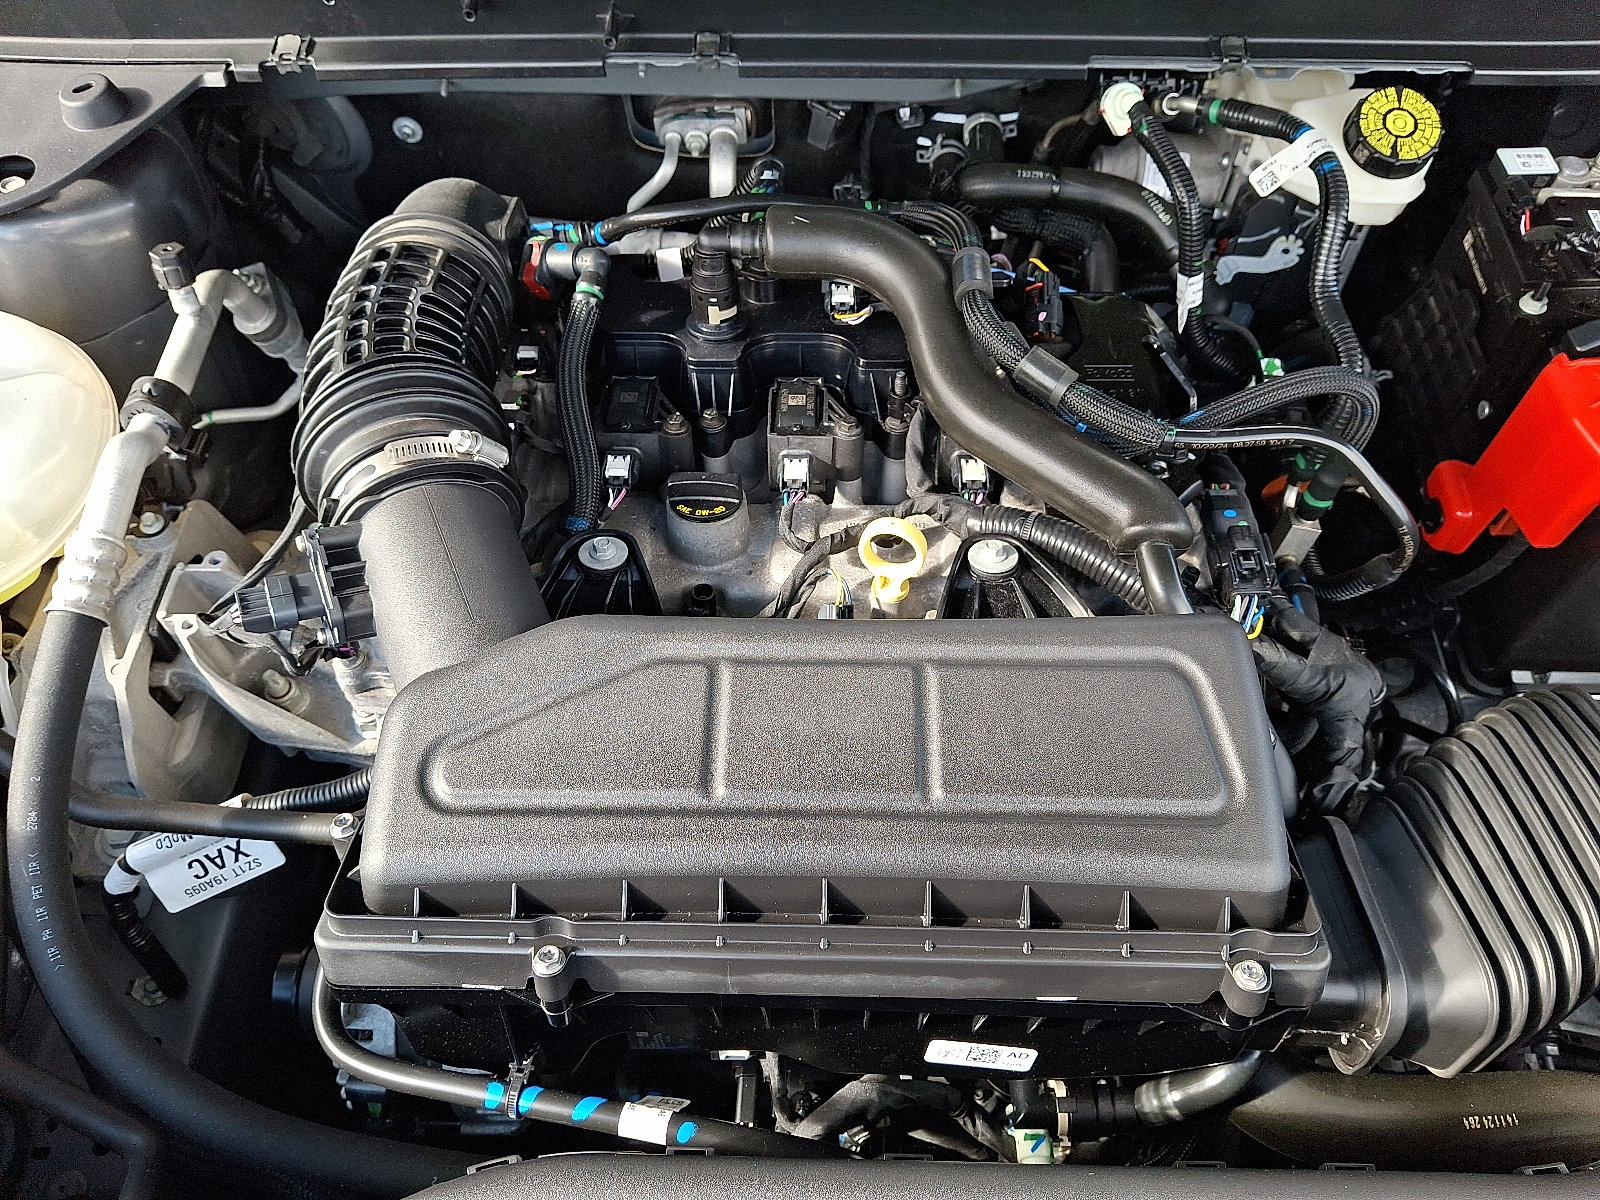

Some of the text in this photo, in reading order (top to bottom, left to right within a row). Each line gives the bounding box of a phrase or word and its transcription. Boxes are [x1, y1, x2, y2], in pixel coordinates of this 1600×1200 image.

[676, 504, 692, 514] SAE
[187, 838, 252, 880] XAC
[184, 857, 262, 898] SZ1T 19A095
[1007, 1051, 1030, 1060] AD
